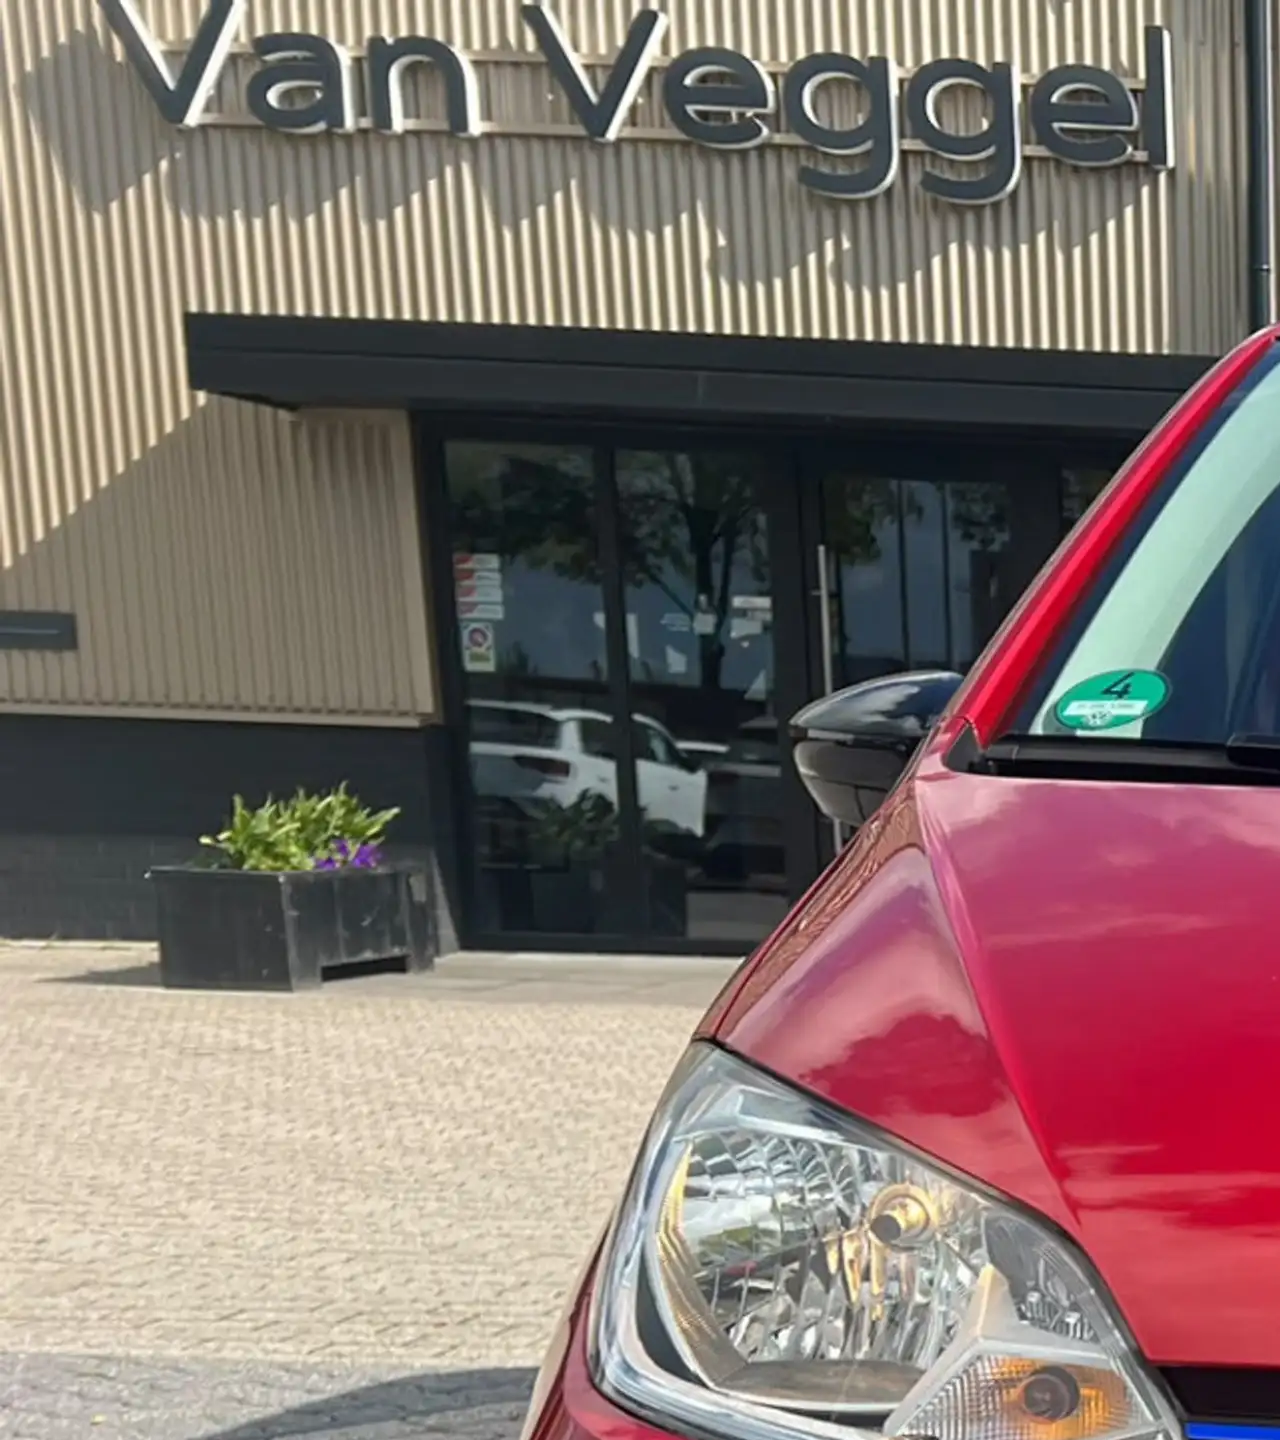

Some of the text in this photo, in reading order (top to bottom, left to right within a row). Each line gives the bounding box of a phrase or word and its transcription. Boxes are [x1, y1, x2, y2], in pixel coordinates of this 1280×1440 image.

[100, 0, 1176, 204] Van Veggel
[1101, 671, 1136, 699] 4
